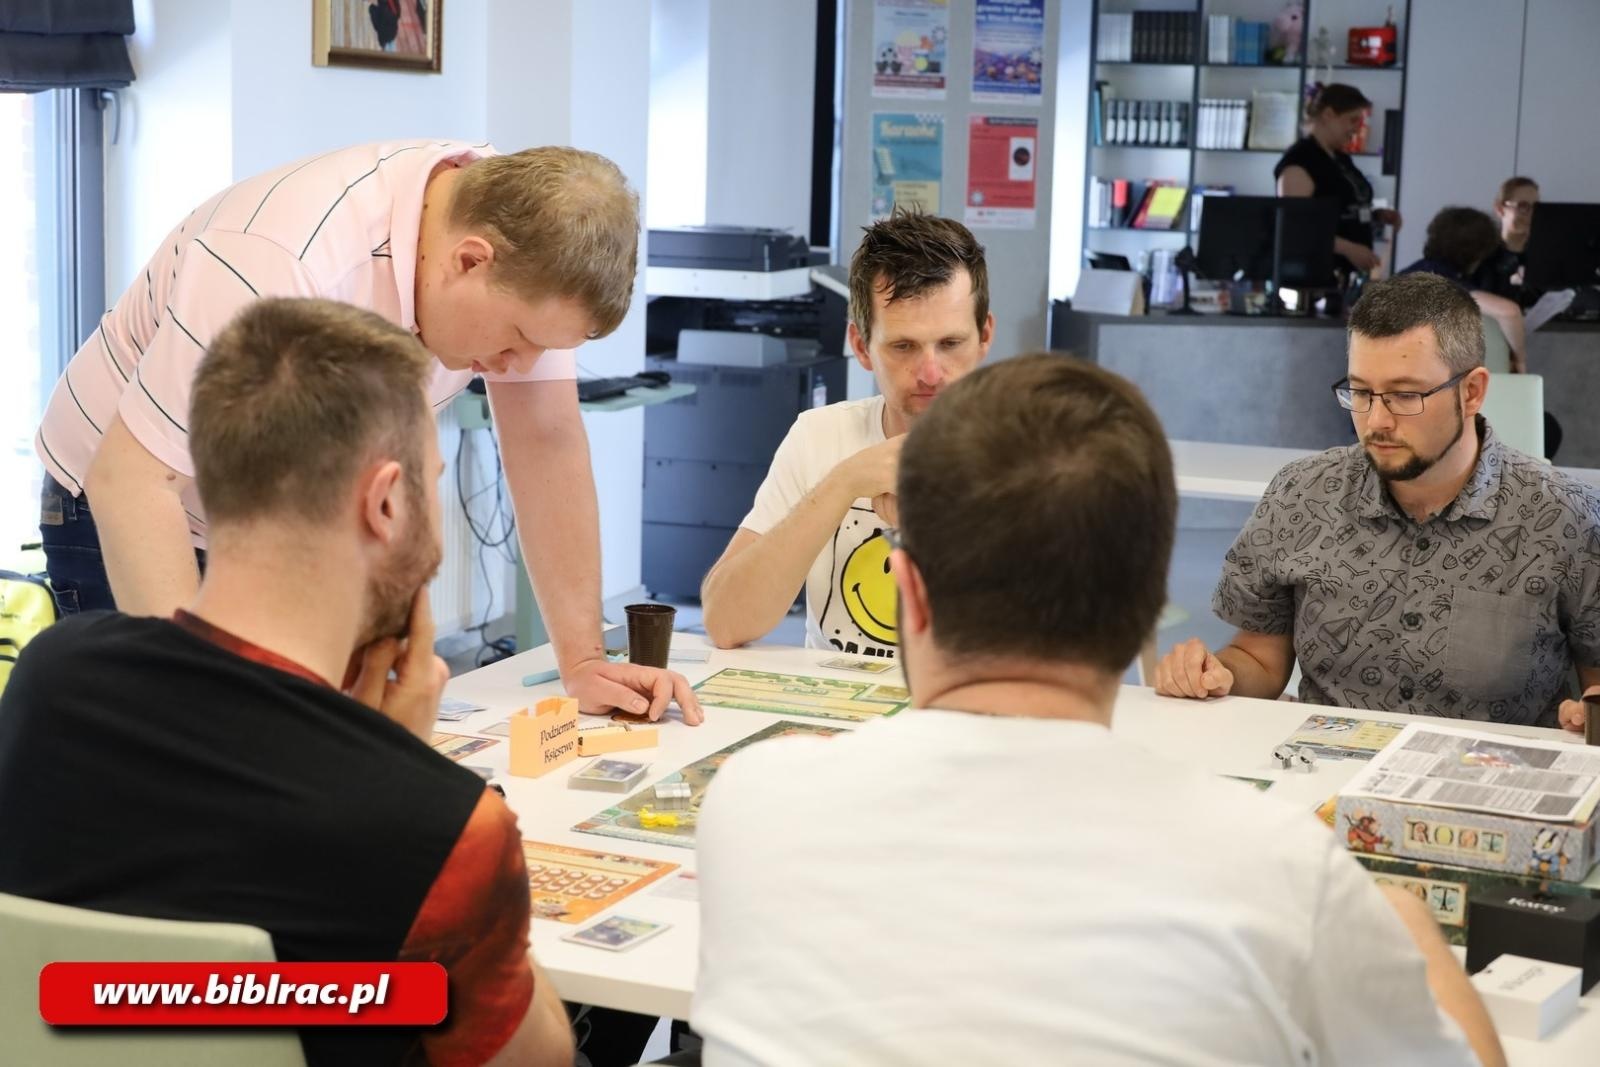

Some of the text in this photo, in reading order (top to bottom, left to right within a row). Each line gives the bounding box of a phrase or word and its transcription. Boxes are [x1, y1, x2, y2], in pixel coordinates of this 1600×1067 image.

[540, 718, 577, 746] Podziemne
[544, 740, 574, 764] Księstwo
[1407, 820, 1505, 854] ROOT
